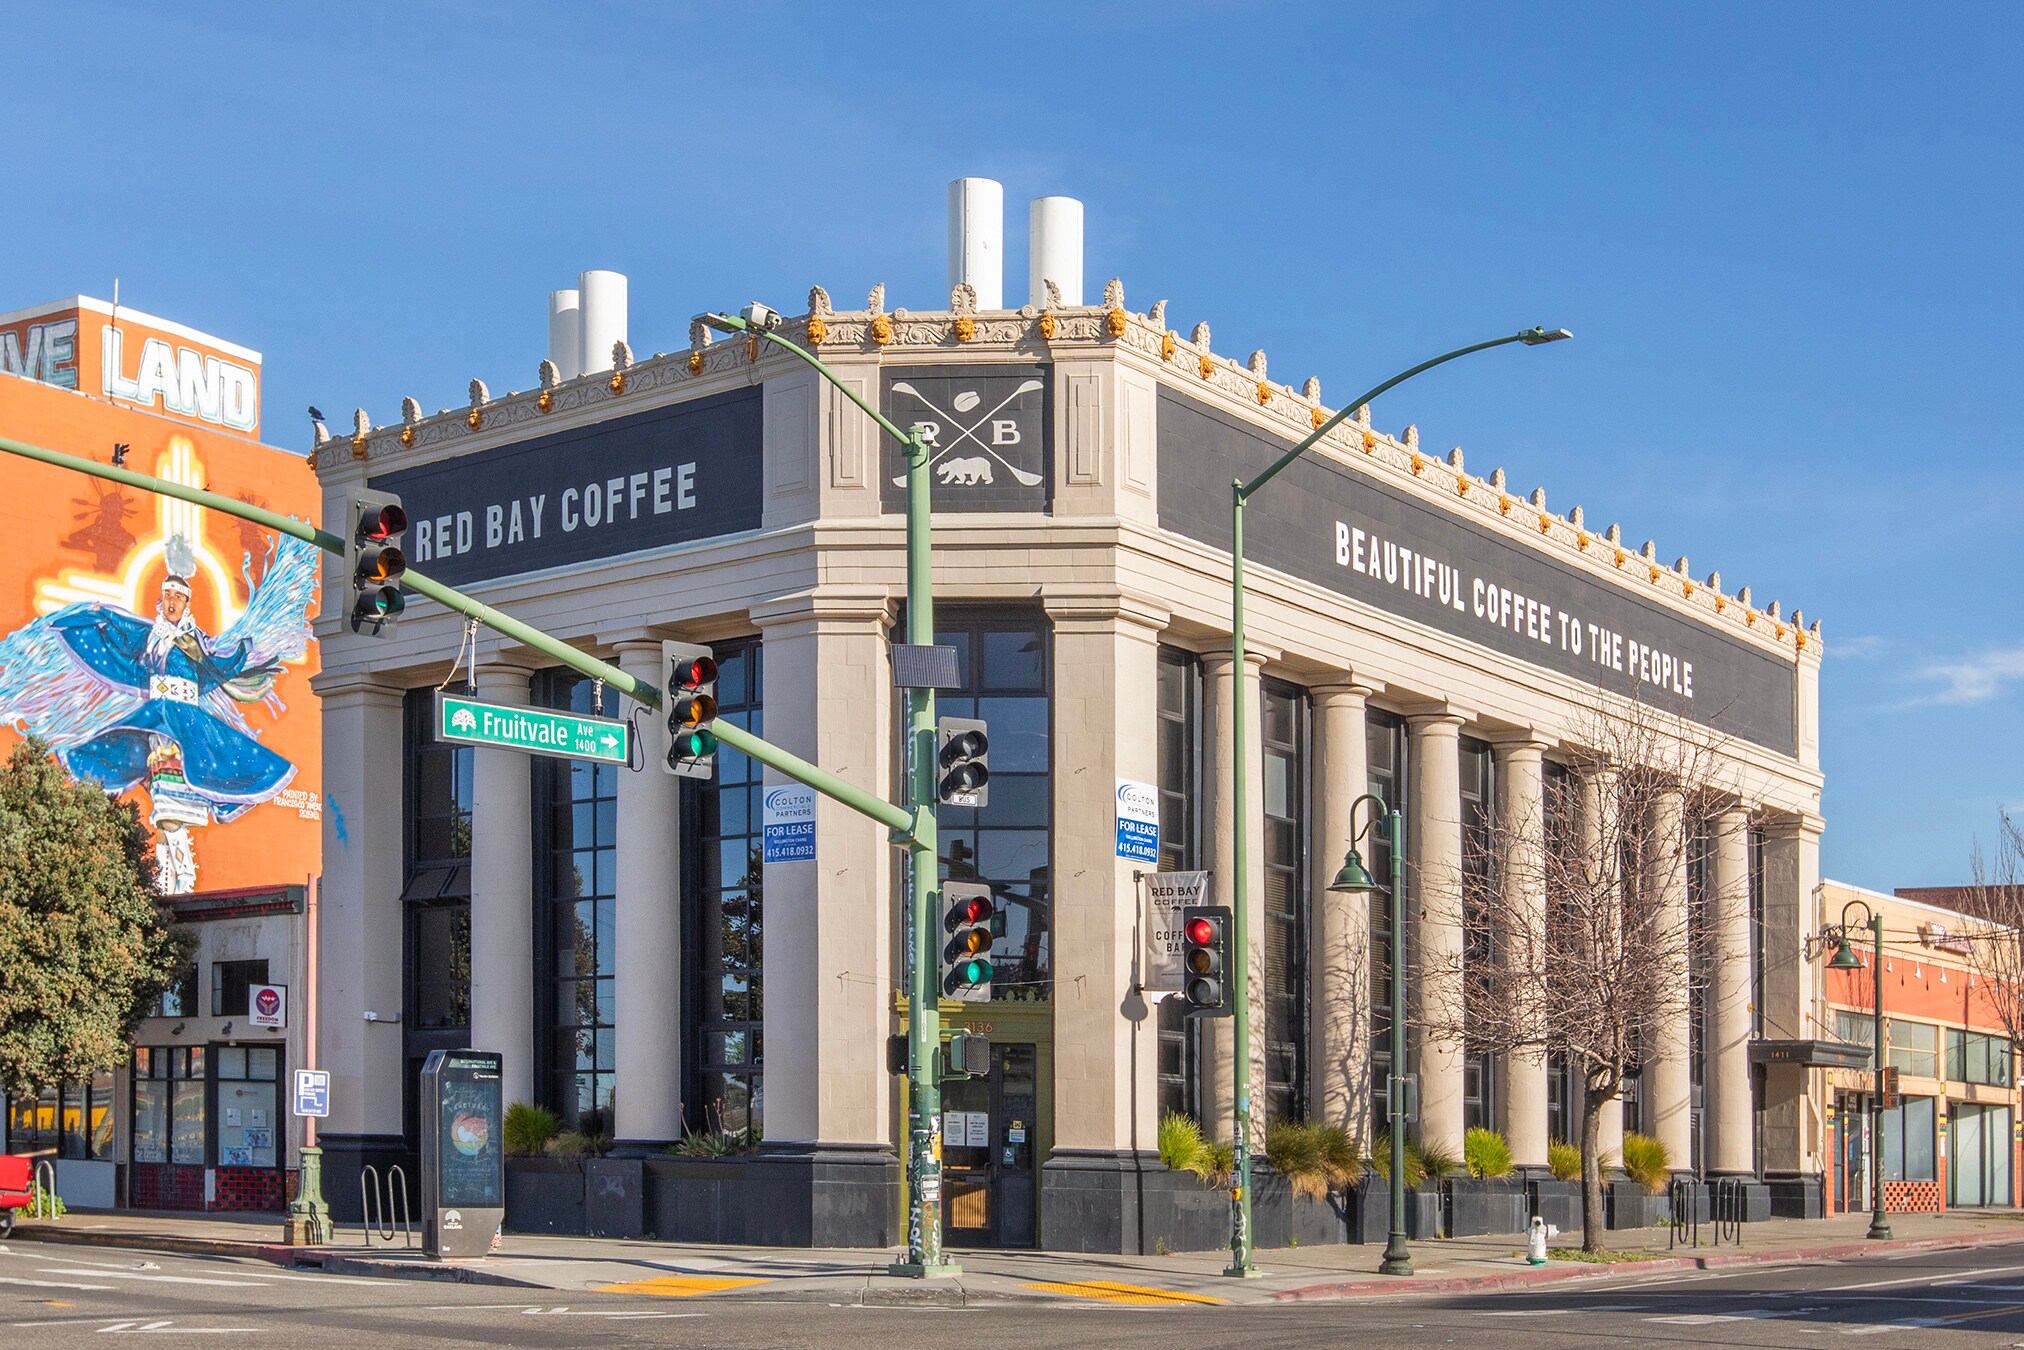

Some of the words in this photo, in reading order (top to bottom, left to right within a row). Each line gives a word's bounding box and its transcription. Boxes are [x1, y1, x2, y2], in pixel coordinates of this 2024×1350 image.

[102, 325, 257, 432] LAND
[992, 420, 1021, 445] B
[415, 510, 473, 563] RED
[486, 494, 546, 549] BAY
[561, 461, 696, 533] COFFEE
[1335, 520, 1465, 612] BEAUTIFUL
[1473, 577, 1552, 645] COFFEE
[1558, 611, 1582, 656] TO
[1588, 623, 1623, 672] THE
[1628, 639, 1693, 699] PEOPLE
[483, 711, 569, 747] Fruitvale
[577, 723, 594, 737] Ave
[575, 738, 597, 753] 1400
[775, 795, 812, 806] COLTON
[958, 795, 971, 803] BUS
[1126, 792, 1155, 805] COLTON
[776, 808, 811, 818] PARTNERS
[1127, 806, 1155, 818] PARTNERS
[766, 826, 785, 837] FOR
[786, 823, 813, 836] LEASE
[1119, 820, 1135, 833] FOR
[1136, 823, 1157, 837] LEASE
[767, 845, 814, 857] 415.418.0932
[1118, 842, 1156, 858] 415.418.0932
[1152, 886, 1174, 897] RED
[1177, 886, 1200, 896] BAY
[1154, 898, 1198, 906] COFFEE
[965, 1021, 993, 1033] 3136
[1771, 1050, 1789, 1059] 1411
